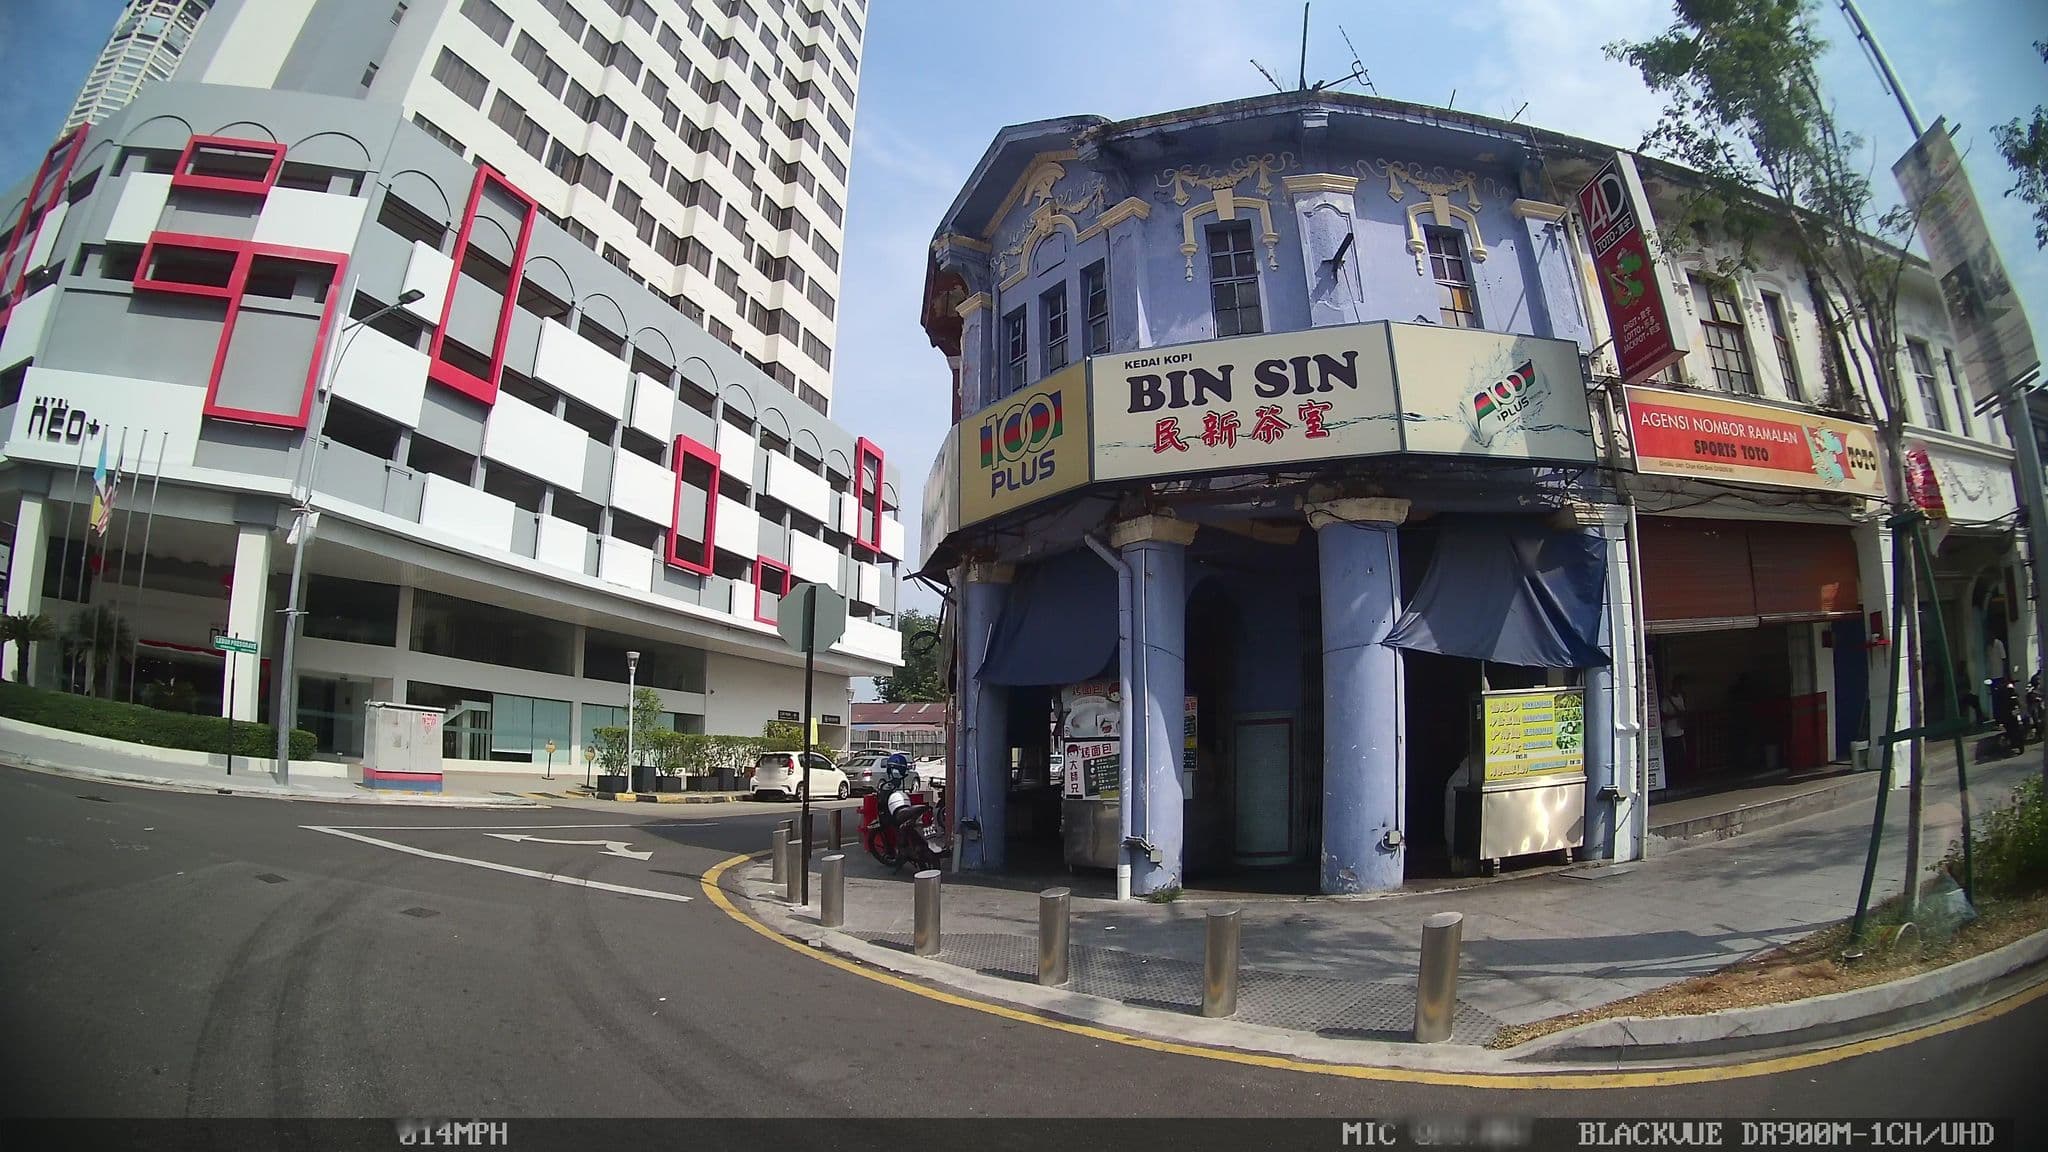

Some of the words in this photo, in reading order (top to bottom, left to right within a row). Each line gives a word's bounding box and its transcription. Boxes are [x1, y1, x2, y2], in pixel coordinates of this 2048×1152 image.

[1590, 173, 1625, 229] 4D
[1597, 231, 1616, 252] TOTO
[1624, 326, 1641, 342] LOTTO
[1624, 332, 1646, 354] JACKPOT
[1124, 355, 1161, 370] KEDAI
[1164, 352, 1193, 365] KOPI
[1126, 364, 1235, 414] BIN
[1254, 350, 1359, 399] SIN
[1487, 371, 1528, 413] 100
[1500, 396, 1530, 422] PLUS
[985, 392, 1056, 471] 100
[1153, 399, 1333, 454] 民新茶室
[1641, 411, 1690, 431] AGENSI
[1693, 417, 1746, 438] NOMBOR
[1748, 425, 1798, 445] RAMALAN
[1694, 439, 1737, 458] SPORTS
[1741, 445, 1769, 462] TOTO
[1847, 446, 1877, 472] TOTO
[991, 449, 1056, 499] PLUS
